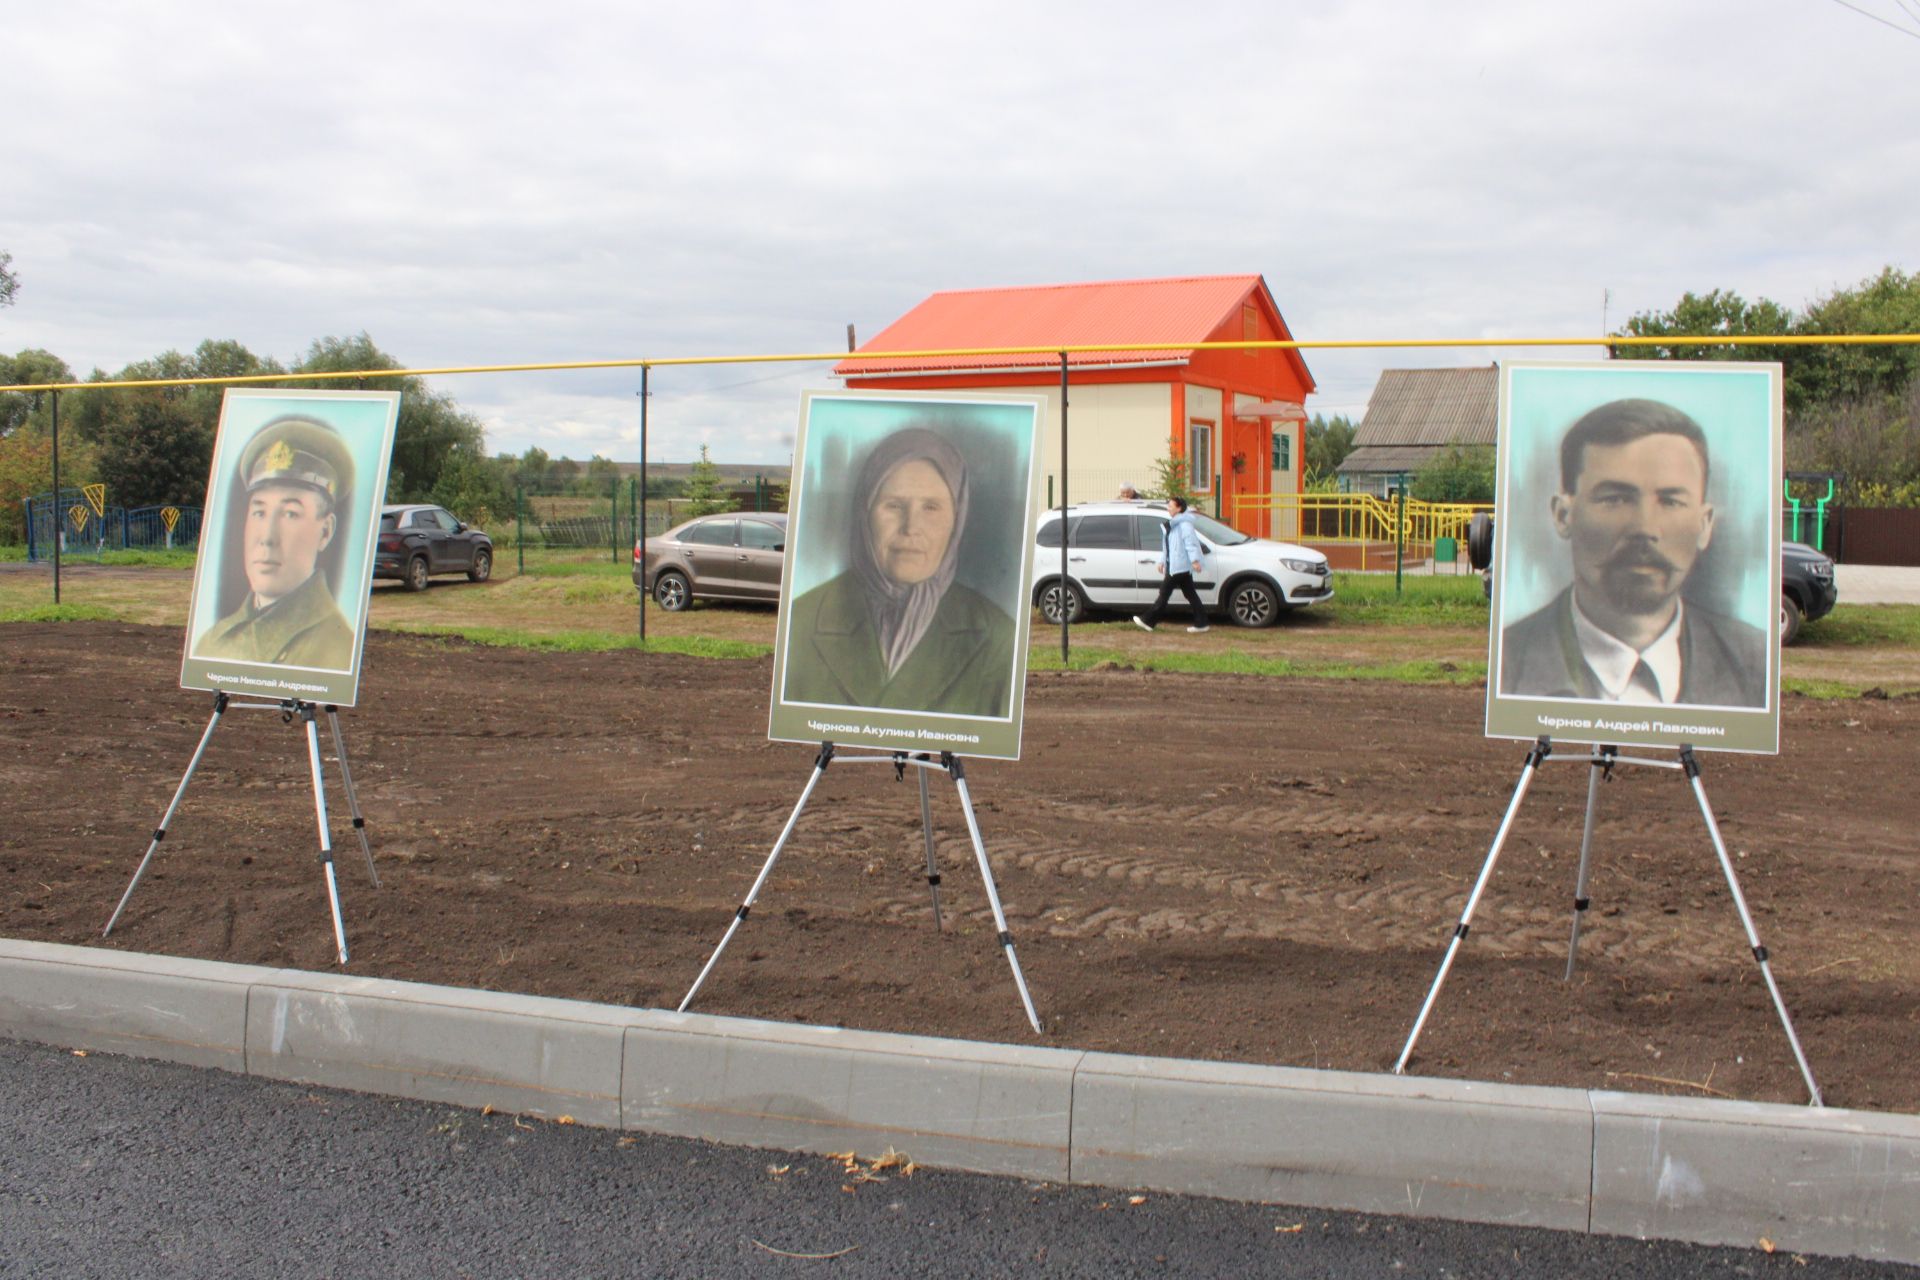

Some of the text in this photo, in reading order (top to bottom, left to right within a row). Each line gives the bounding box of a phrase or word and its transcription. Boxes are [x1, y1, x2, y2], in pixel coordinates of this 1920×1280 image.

[206, 672, 328, 692] Чернов Николай Андреевич
[807, 720, 980, 743] Чернова Акулина Ивановна
[1537, 715, 1725, 736] Чернов Андрей Павлович
